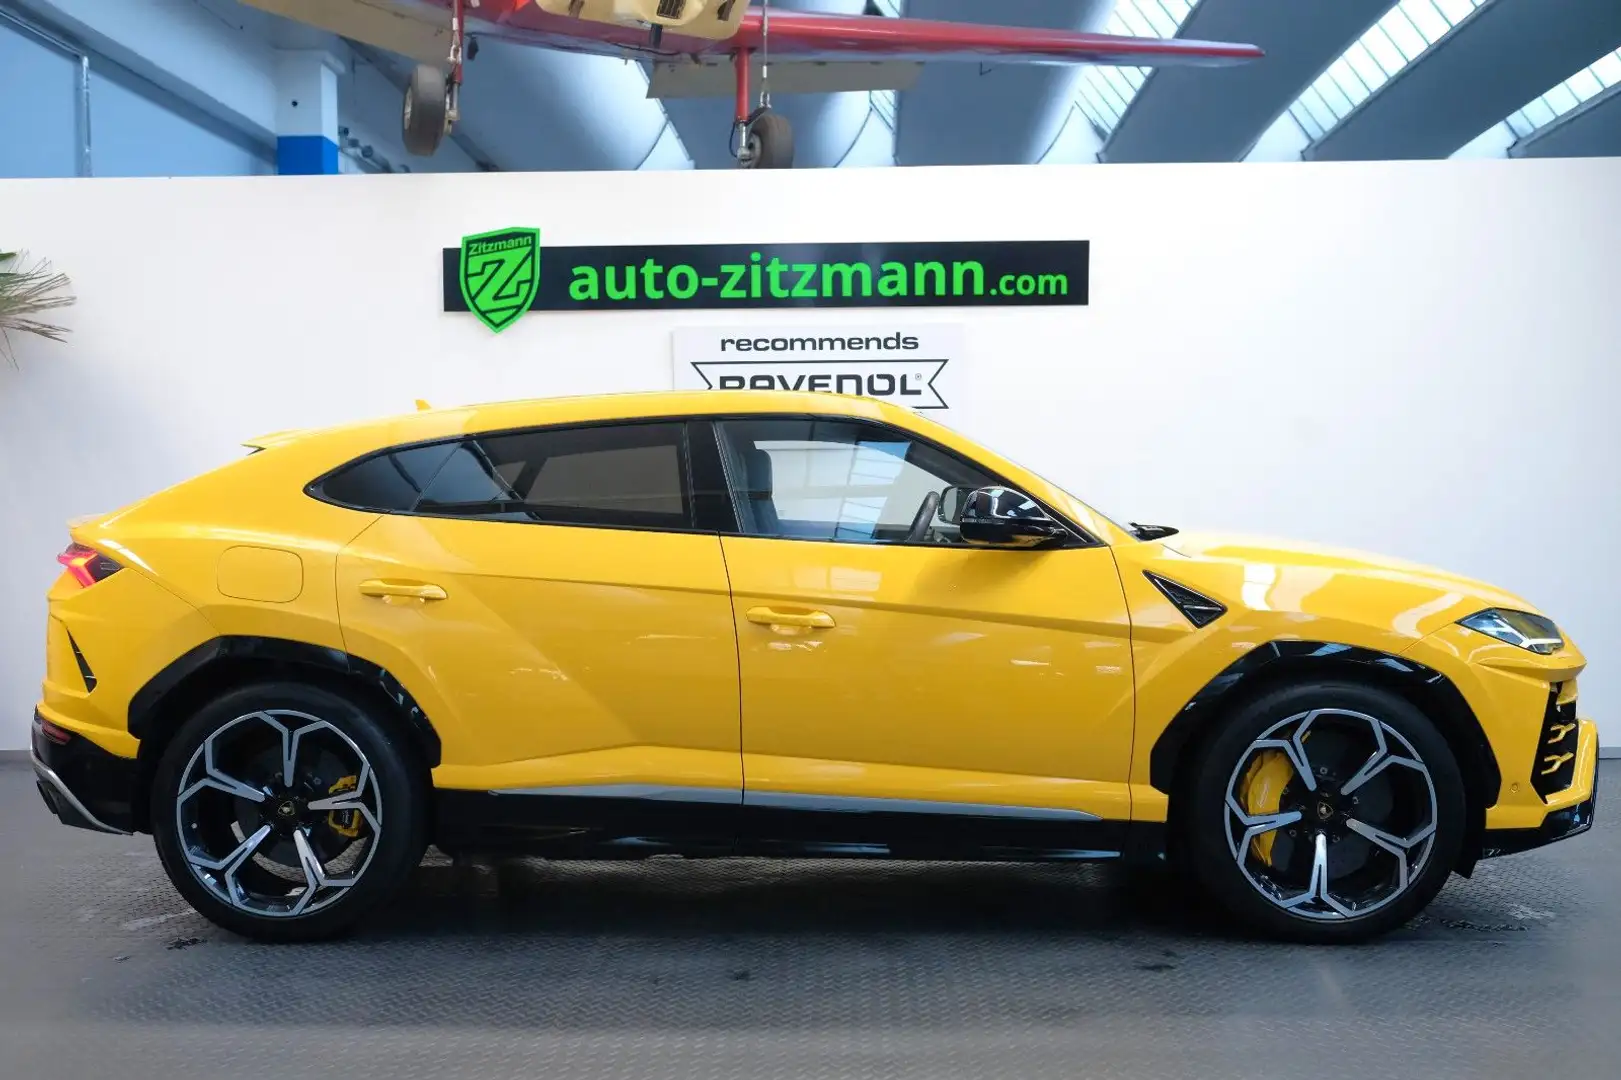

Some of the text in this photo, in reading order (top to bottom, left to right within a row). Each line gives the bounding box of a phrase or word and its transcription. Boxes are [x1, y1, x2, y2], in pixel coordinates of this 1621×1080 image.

[468, 235, 532, 256] Zitzmann
[568, 251, 1069, 301] auto-zitzmann.com
[720, 331, 919, 352] recommends
